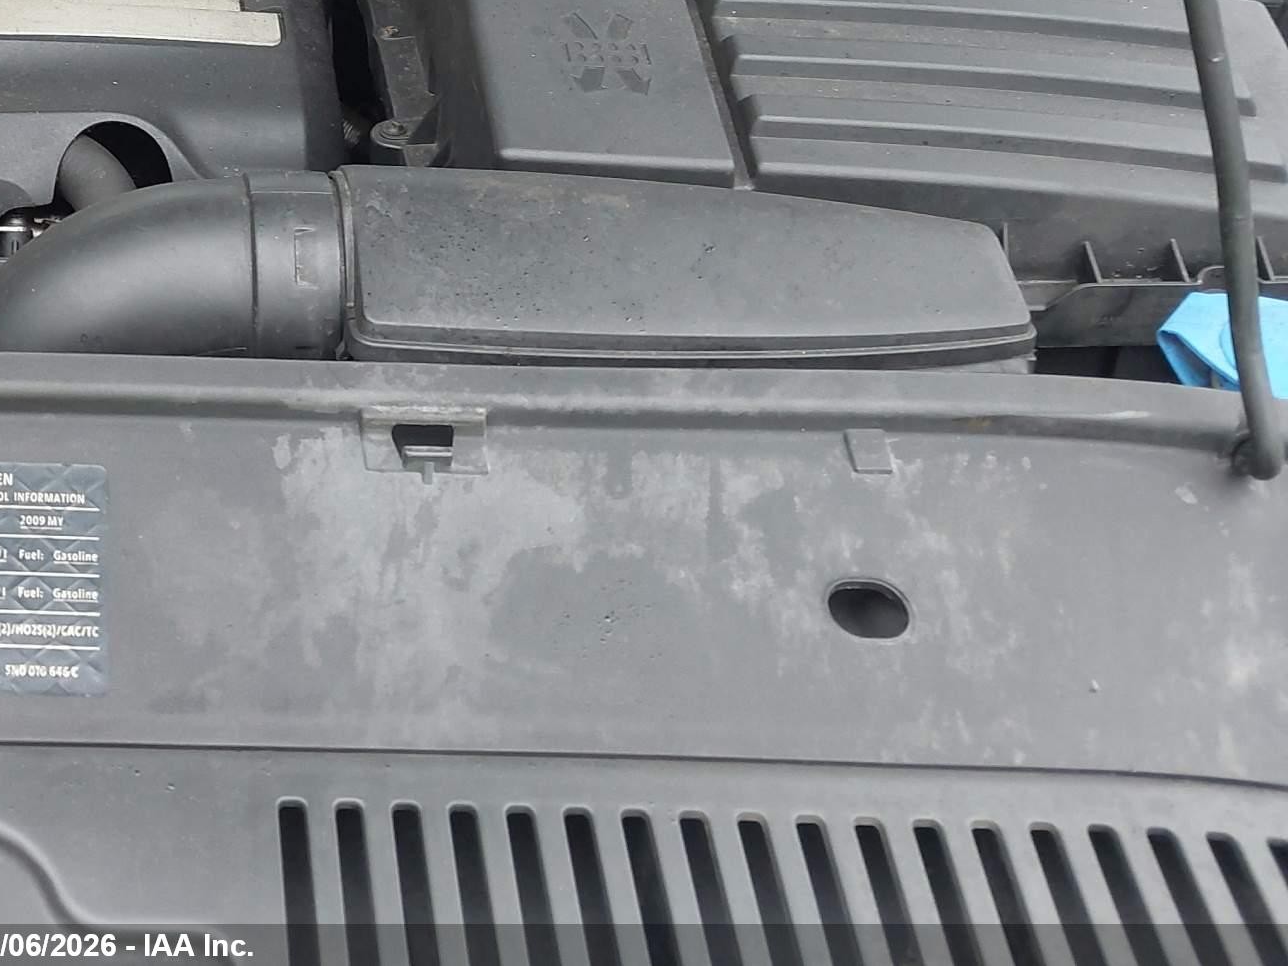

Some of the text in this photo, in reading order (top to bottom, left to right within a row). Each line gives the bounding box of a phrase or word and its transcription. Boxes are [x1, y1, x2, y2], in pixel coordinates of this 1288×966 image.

[13, 491, 86, 504] INFORMATION
[19, 515, 64, 526] 2009 MY
[18, 549, 45, 561] Fuel:
[53, 550, 99, 562] Gasoline
[17, 586, 44, 598] Fuel:
[53, 588, 99, 601] Gasoline
